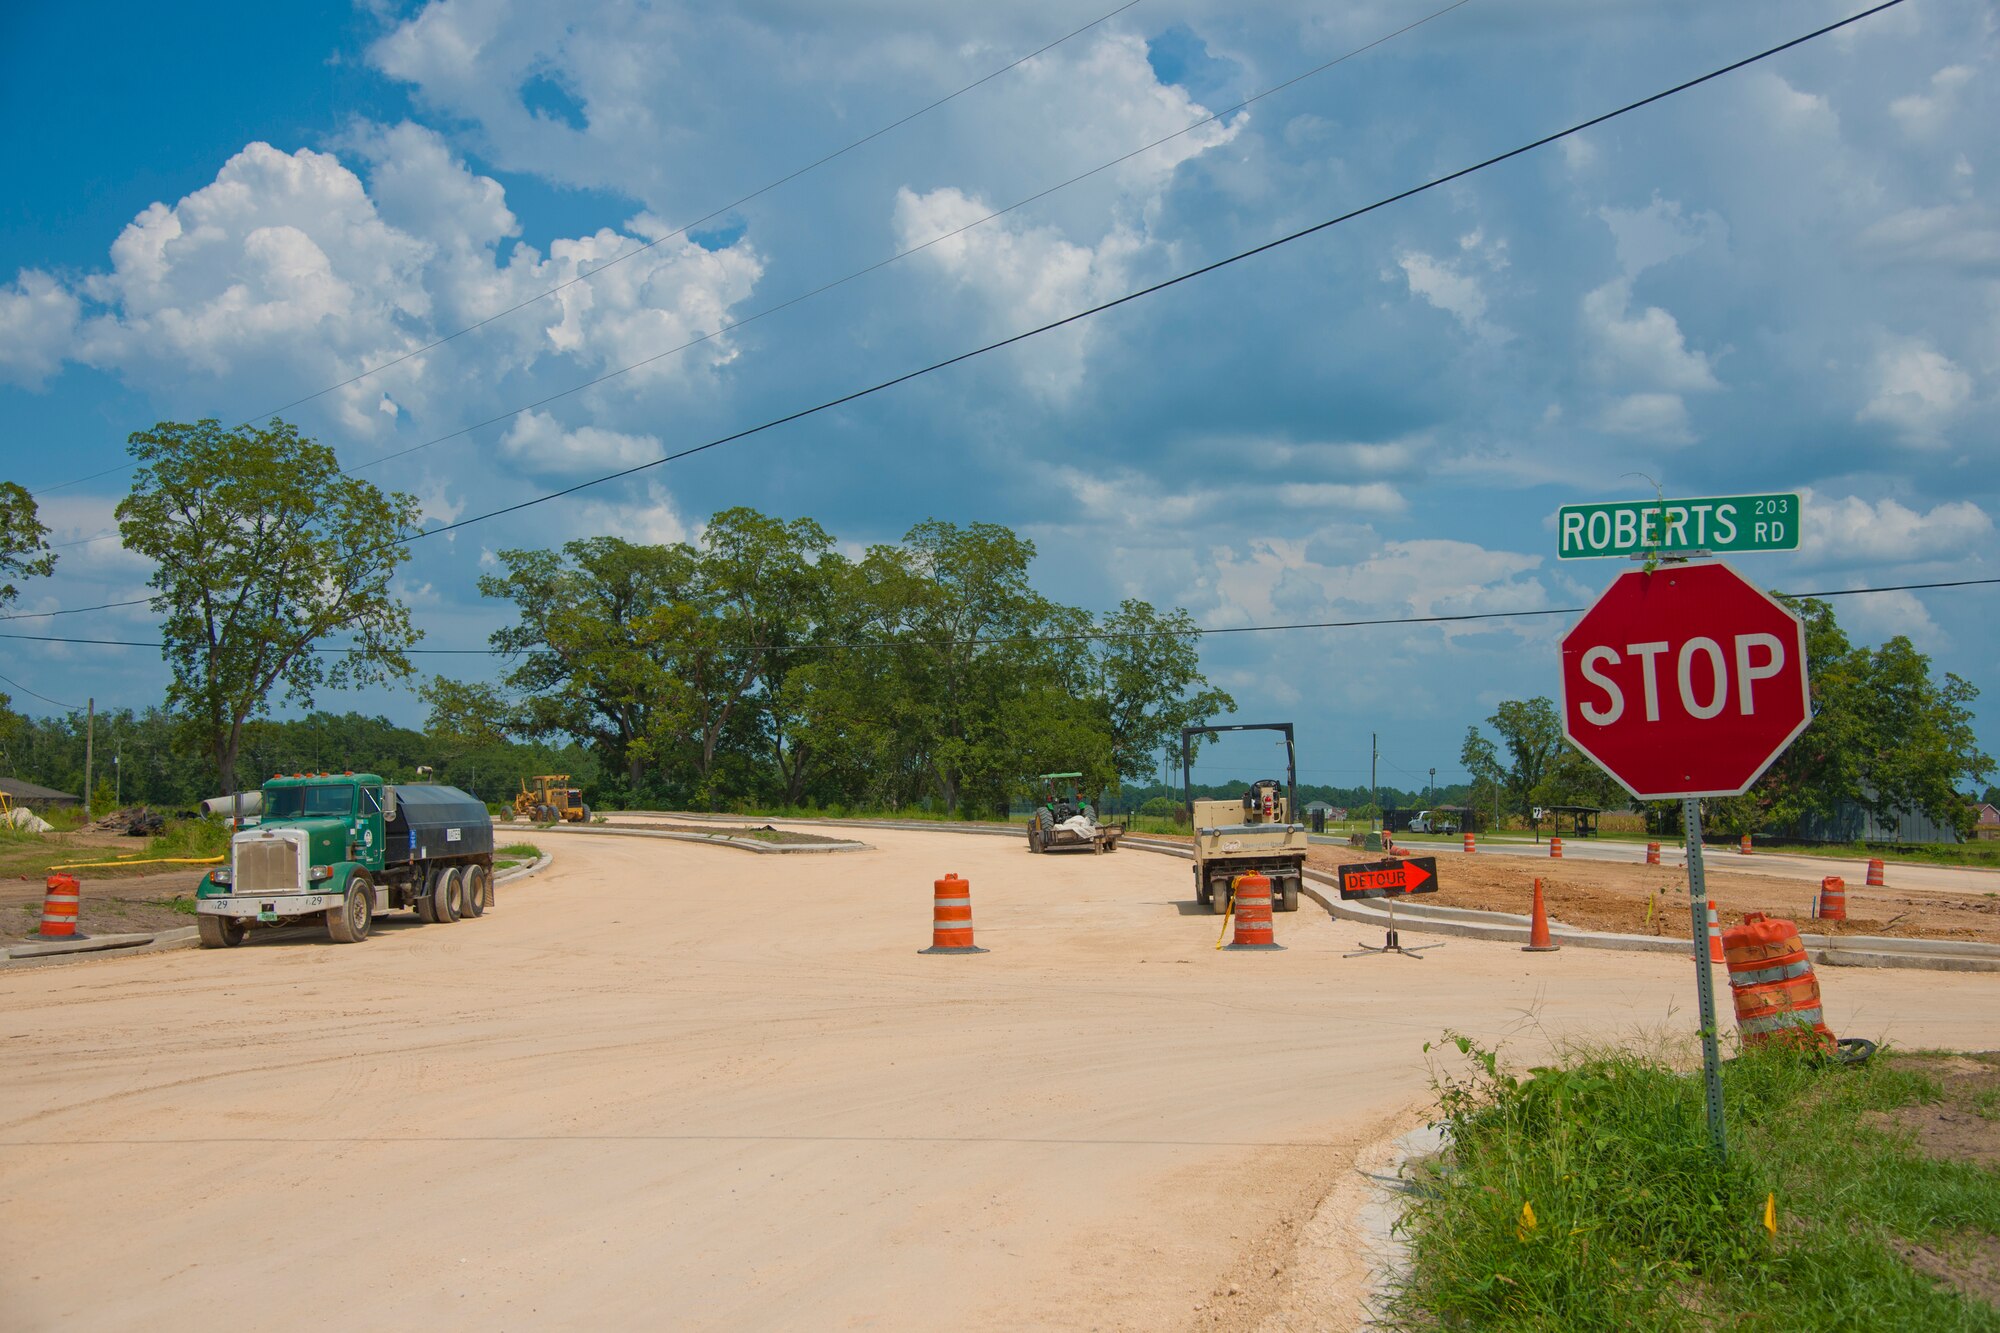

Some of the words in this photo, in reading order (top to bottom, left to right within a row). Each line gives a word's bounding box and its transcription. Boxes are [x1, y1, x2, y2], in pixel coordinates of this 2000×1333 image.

[1755, 499, 1788, 515] 203
[1562, 503, 1737, 551] ROBERTS
[1754, 521, 1785, 543] RD
[1579, 632, 1785, 726] STOP
[1348, 871, 1406, 888] DETOUR
